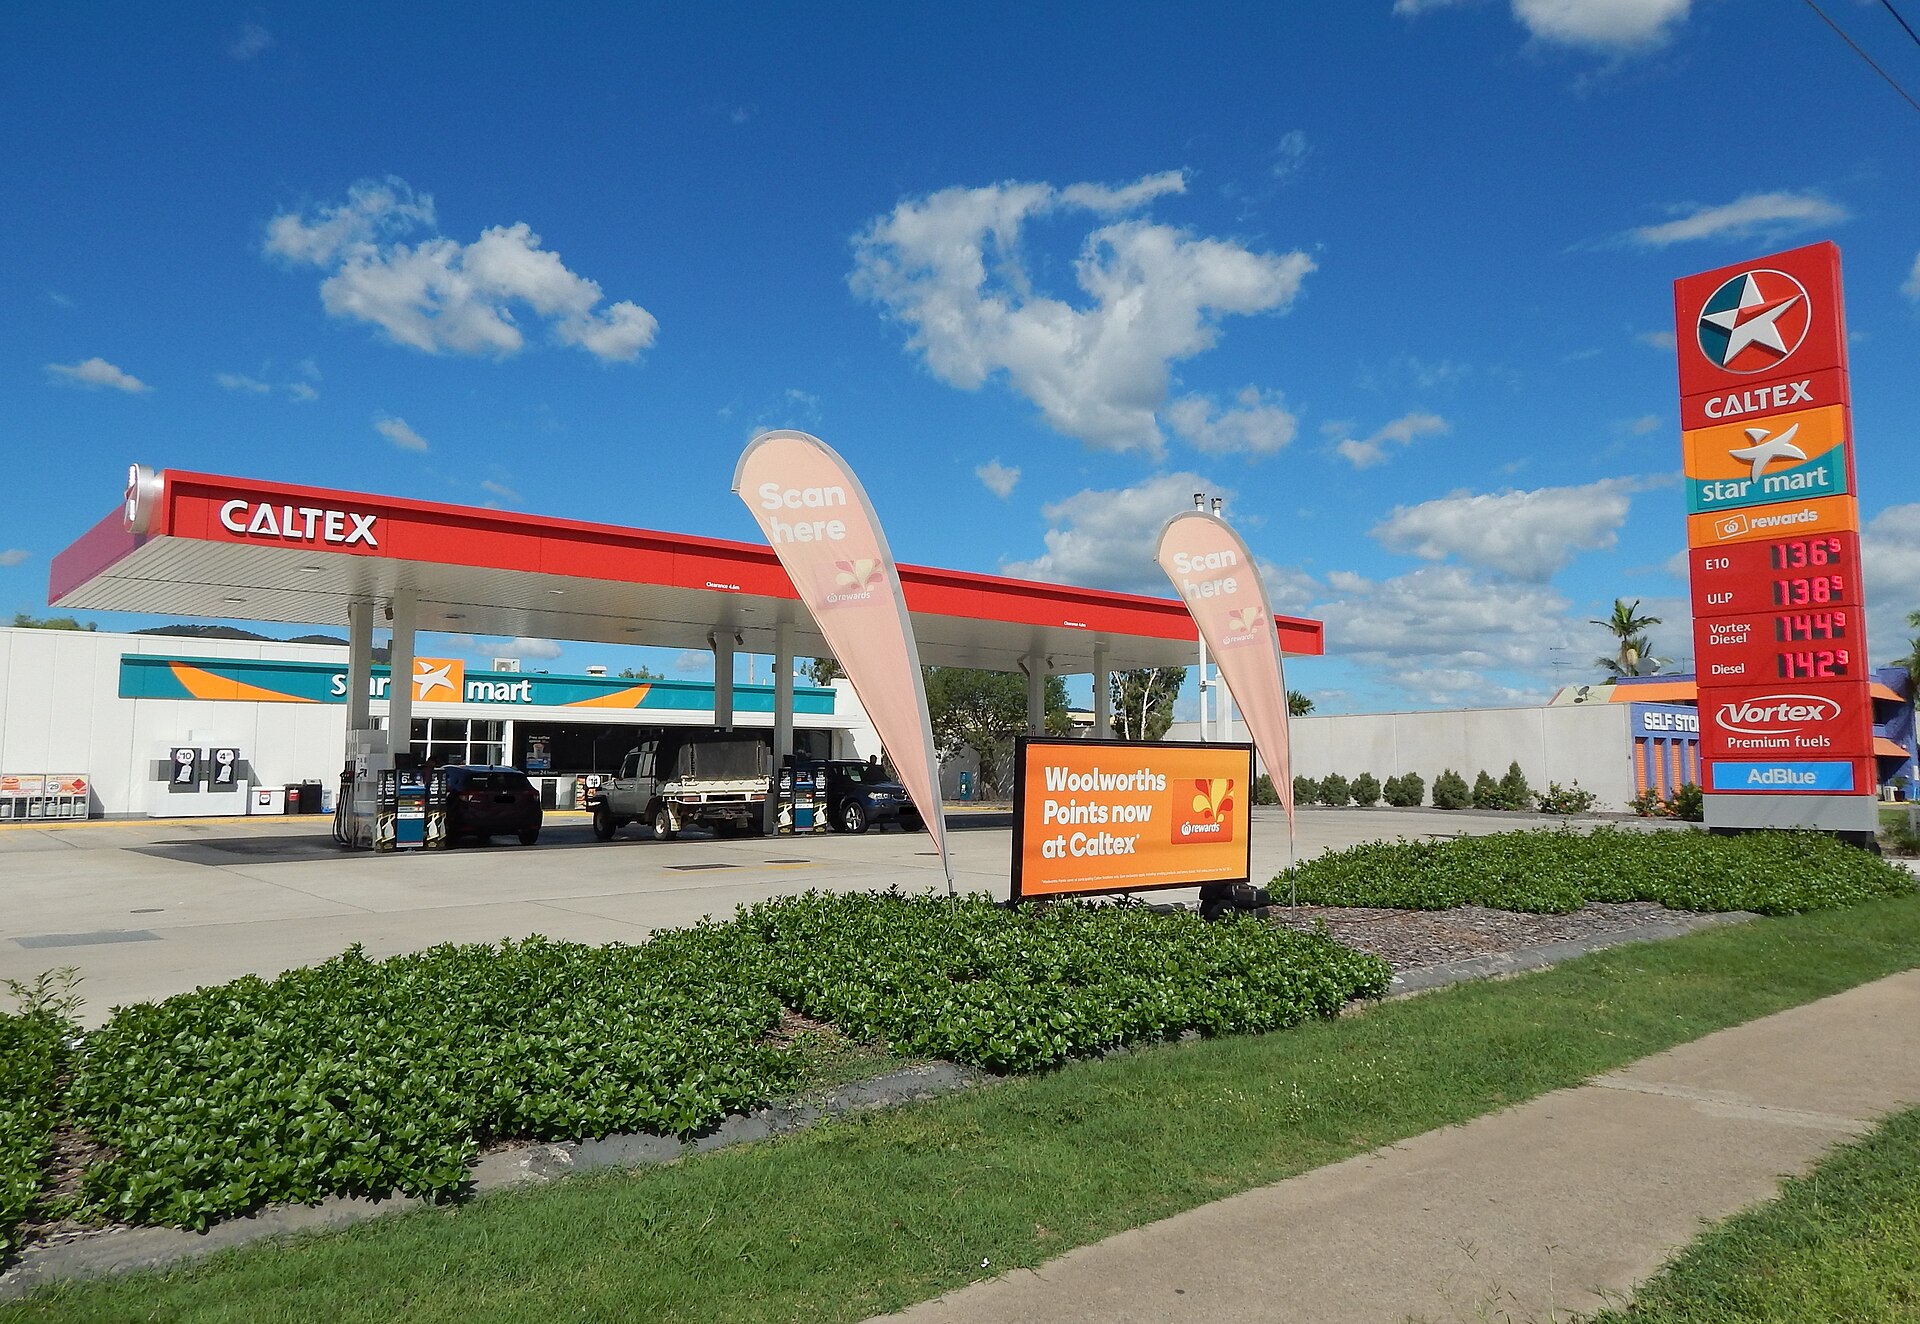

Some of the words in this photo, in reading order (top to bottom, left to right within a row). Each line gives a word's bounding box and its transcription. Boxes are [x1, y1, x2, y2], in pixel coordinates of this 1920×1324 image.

[1704, 379, 1814, 419] CALTEX
[1702, 480, 1752, 502] star
[1763, 466, 1829, 494] mart
[758, 482, 847, 510] Scan
[220, 499, 378, 546] CALTEX
[769, 515, 847, 544] here
[1751, 508, 1819, 529] rewards
[1173, 549, 1238, 574] Scan
[1705, 557, 1730, 571] E10
[837, 591, 871, 601] rewards
[1183, 577, 1238, 601] here
[1707, 592, 1733, 605] ULP
[1230, 633, 1255, 643] rewards
[1709, 622, 1751, 634] Vortex
[1709, 633, 1747, 645] Diesel
[1711, 663, 1746, 675] Diesel
[329, 673, 391, 697] sr
[467, 679, 532, 702] mart
[1643, 711, 1674, 731] SELF
[1674, 713, 1700, 733] STO
[1721, 702, 1826, 724] Vortex
[1727, 736, 1790, 749] Premium
[1794, 734, 1831, 748] fuels
[1045, 766, 1167, 792] Woolworths
[1746, 767, 1817, 785] AdBlue
[1043, 798, 1109, 825] Points
[1111, 804, 1153, 823] now
[1191, 822, 1221, 834] rewards
[1041, 833, 1067, 859] at
